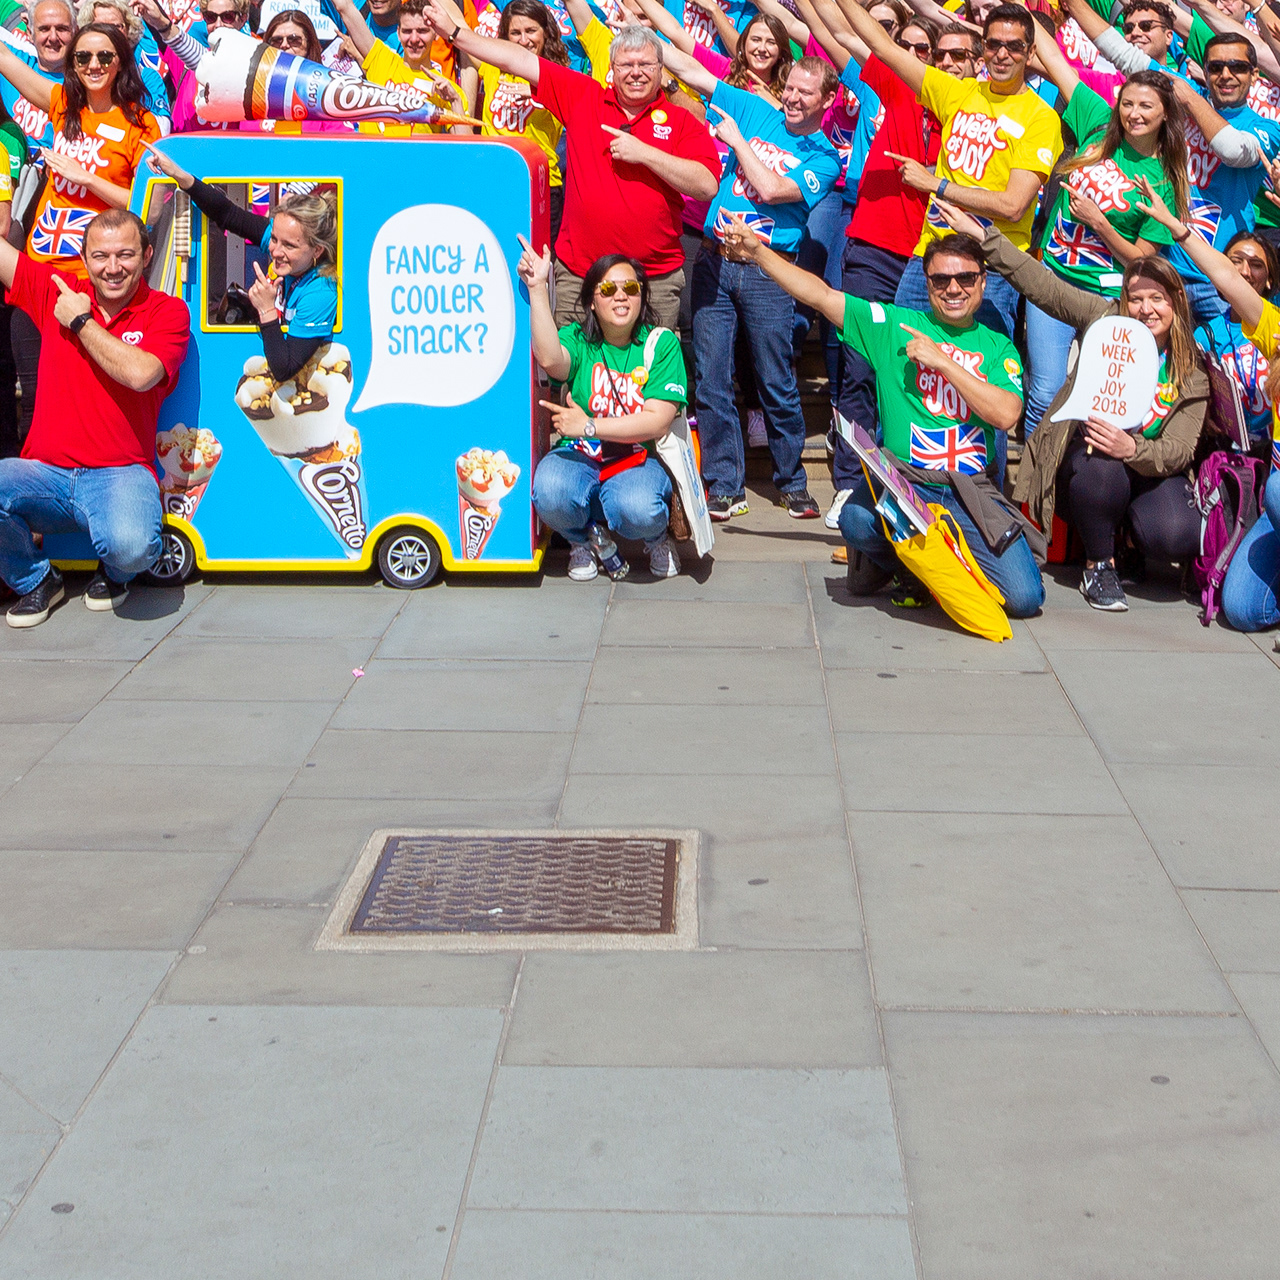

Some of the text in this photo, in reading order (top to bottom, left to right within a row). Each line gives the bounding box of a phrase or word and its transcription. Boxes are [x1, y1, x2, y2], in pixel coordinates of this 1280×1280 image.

[307, 69, 322, 109] CLASSICO
[324, 70, 426, 117] Cornetto
[493, 104, 532, 133] JOY
[948, 141, 994, 179] JOY
[474, 243, 490, 273] A
[1112, 326, 1132, 343] UK
[1101, 342, 1136, 364] WEEK
[1107, 362, 1124, 377] OF
[1100, 380, 1126, 398] JOY
[1092, 396, 1127, 417] 2018
[299, 453, 368, 550] Cornetto
